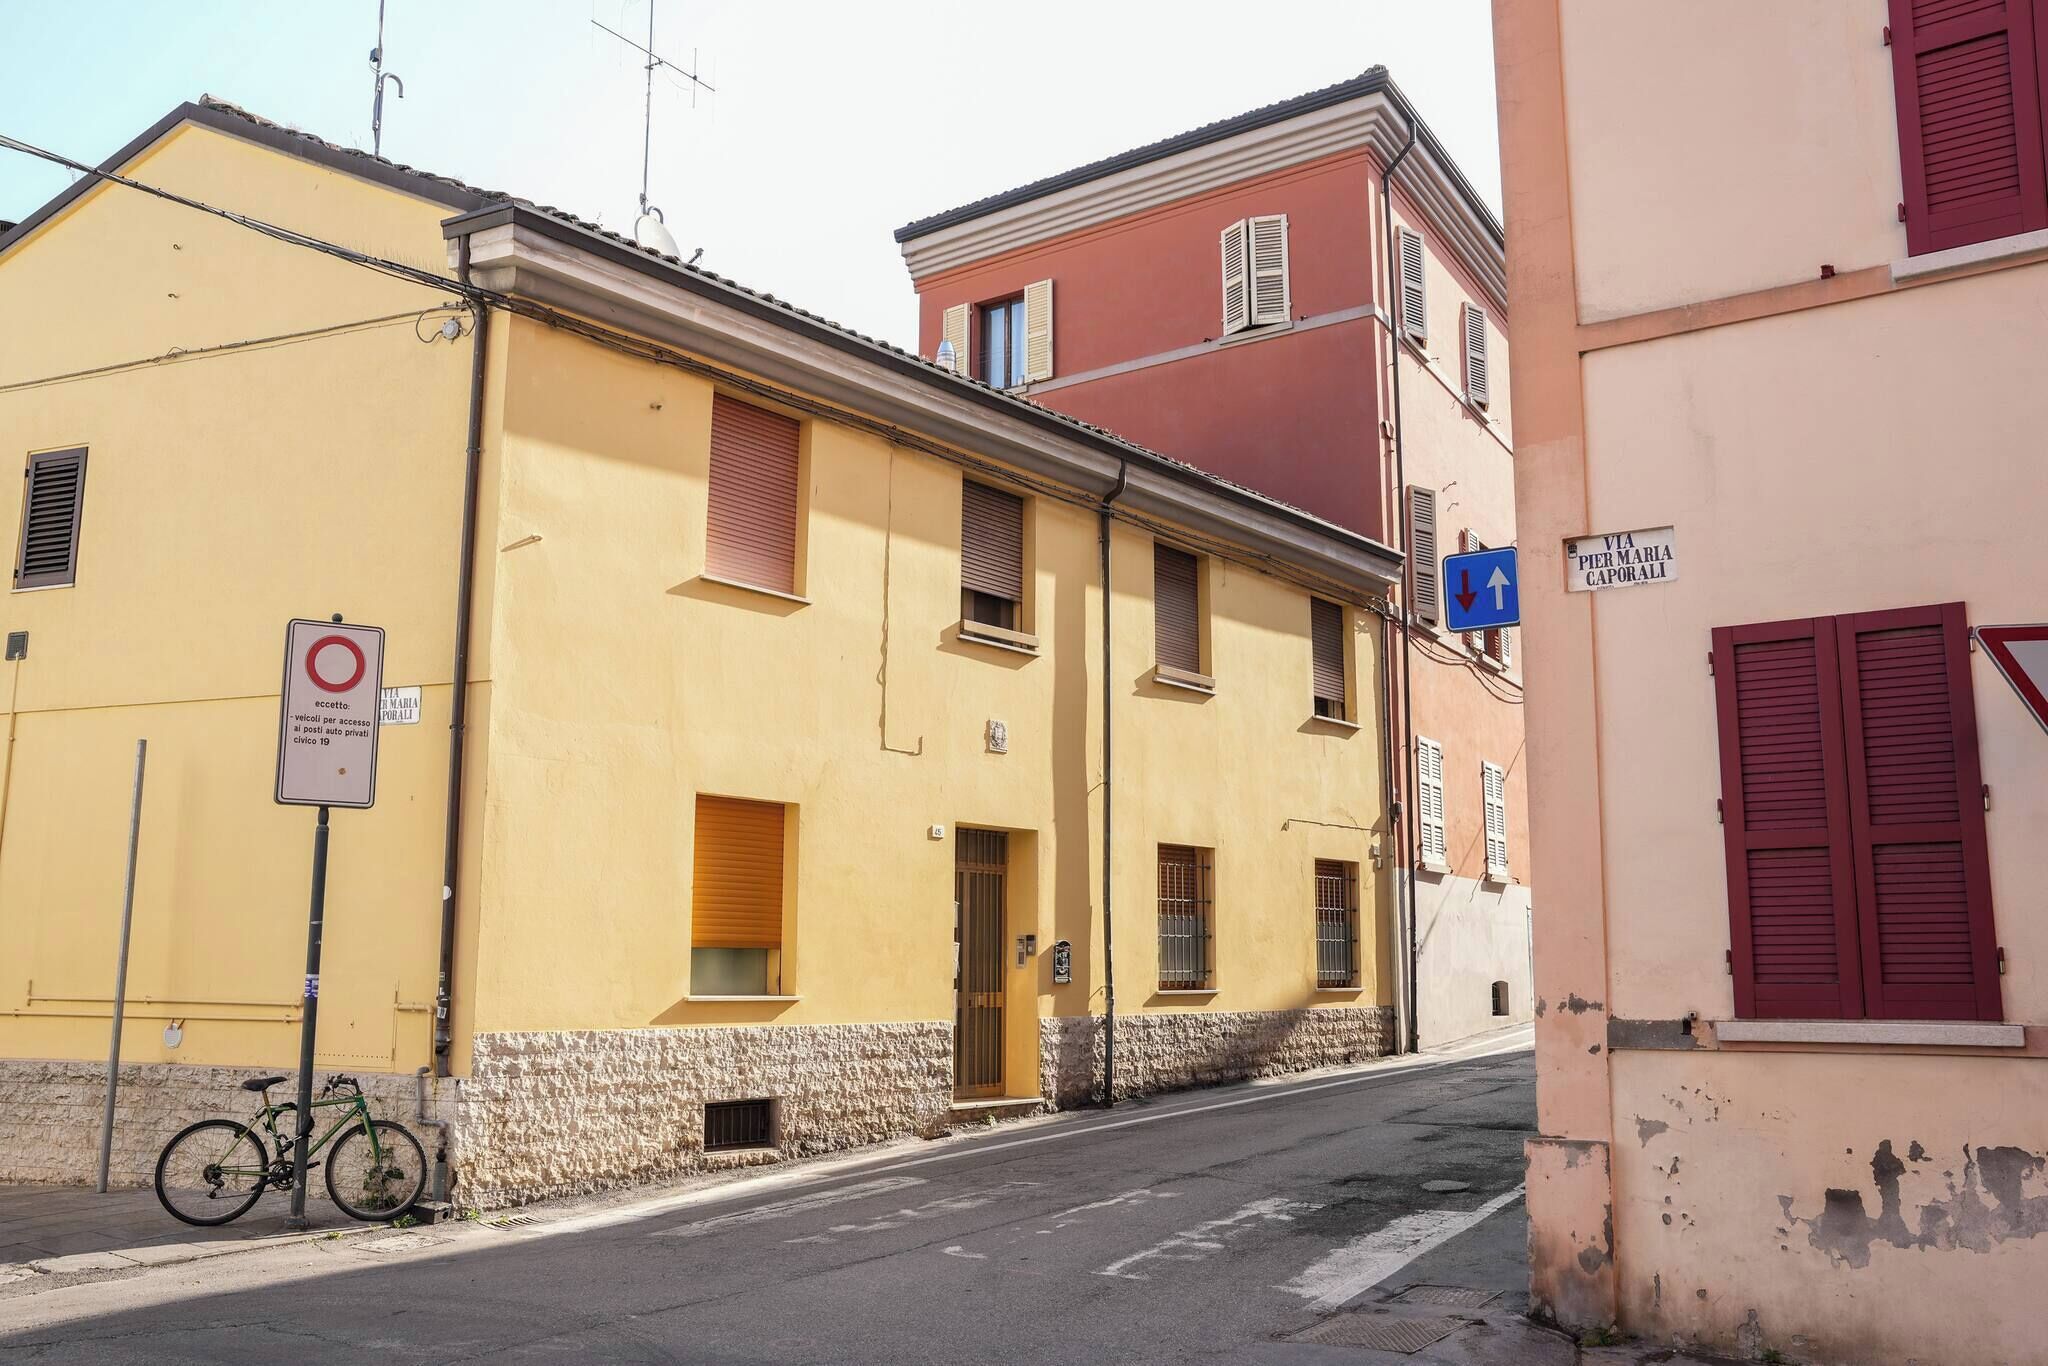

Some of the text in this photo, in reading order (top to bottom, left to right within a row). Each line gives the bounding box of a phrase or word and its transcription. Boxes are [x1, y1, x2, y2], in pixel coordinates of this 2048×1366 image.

[1604, 533, 1634, 551] VIA
[1579, 545, 1673, 570] PIER MARIA
[1586, 562, 1666, 586] CAPORALI
[390, 698, 418, 709] MARIA
[382, 709, 413, 720] PORALI
[339, 718, 371, 727] accesso
[294, 724, 301, 732] ai
[303, 726, 323, 734] posti
[345, 729, 369, 737] privati
[294, 736, 330, 746] civico 19
